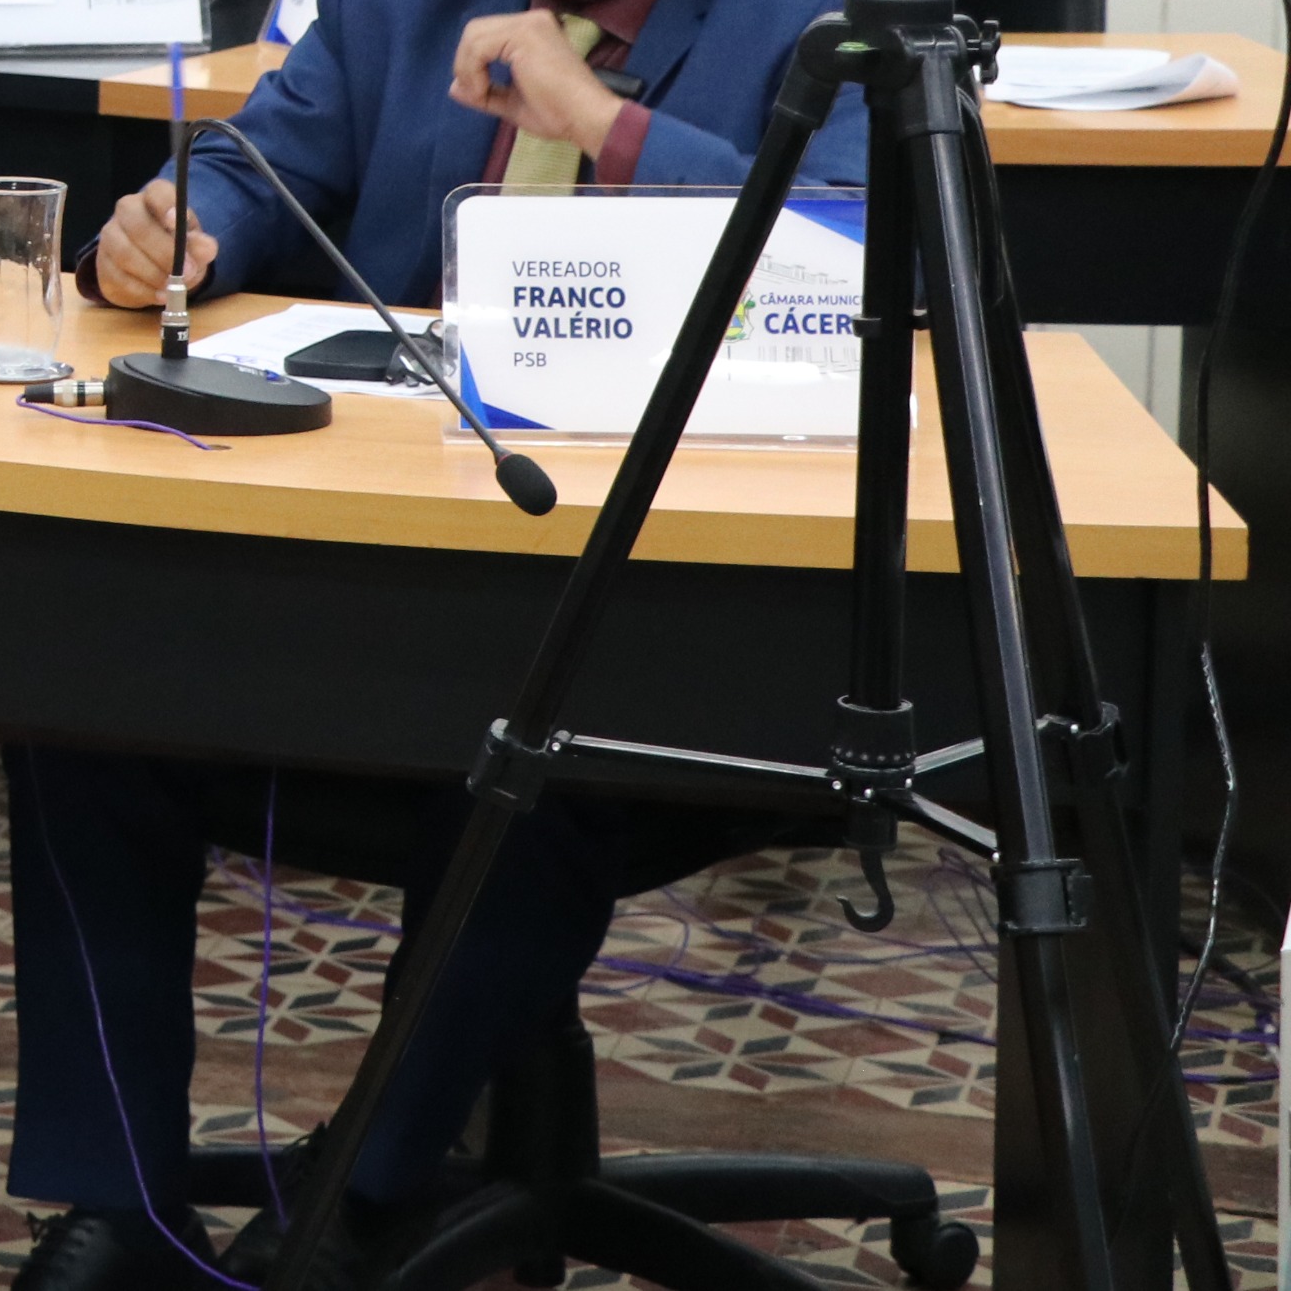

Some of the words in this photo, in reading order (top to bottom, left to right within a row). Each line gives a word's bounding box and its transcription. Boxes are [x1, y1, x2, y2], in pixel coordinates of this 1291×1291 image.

[512, 261, 621, 278] VEREADOR
[513, 286, 626, 309] FRANCO
[760, 292, 814, 305] CÂMARA
[818, 295, 862, 306] MUNIC
[513, 311, 633, 340] VALÉRIO
[764, 307, 853, 334] CÁCER
[513, 352, 547, 367] PSB
